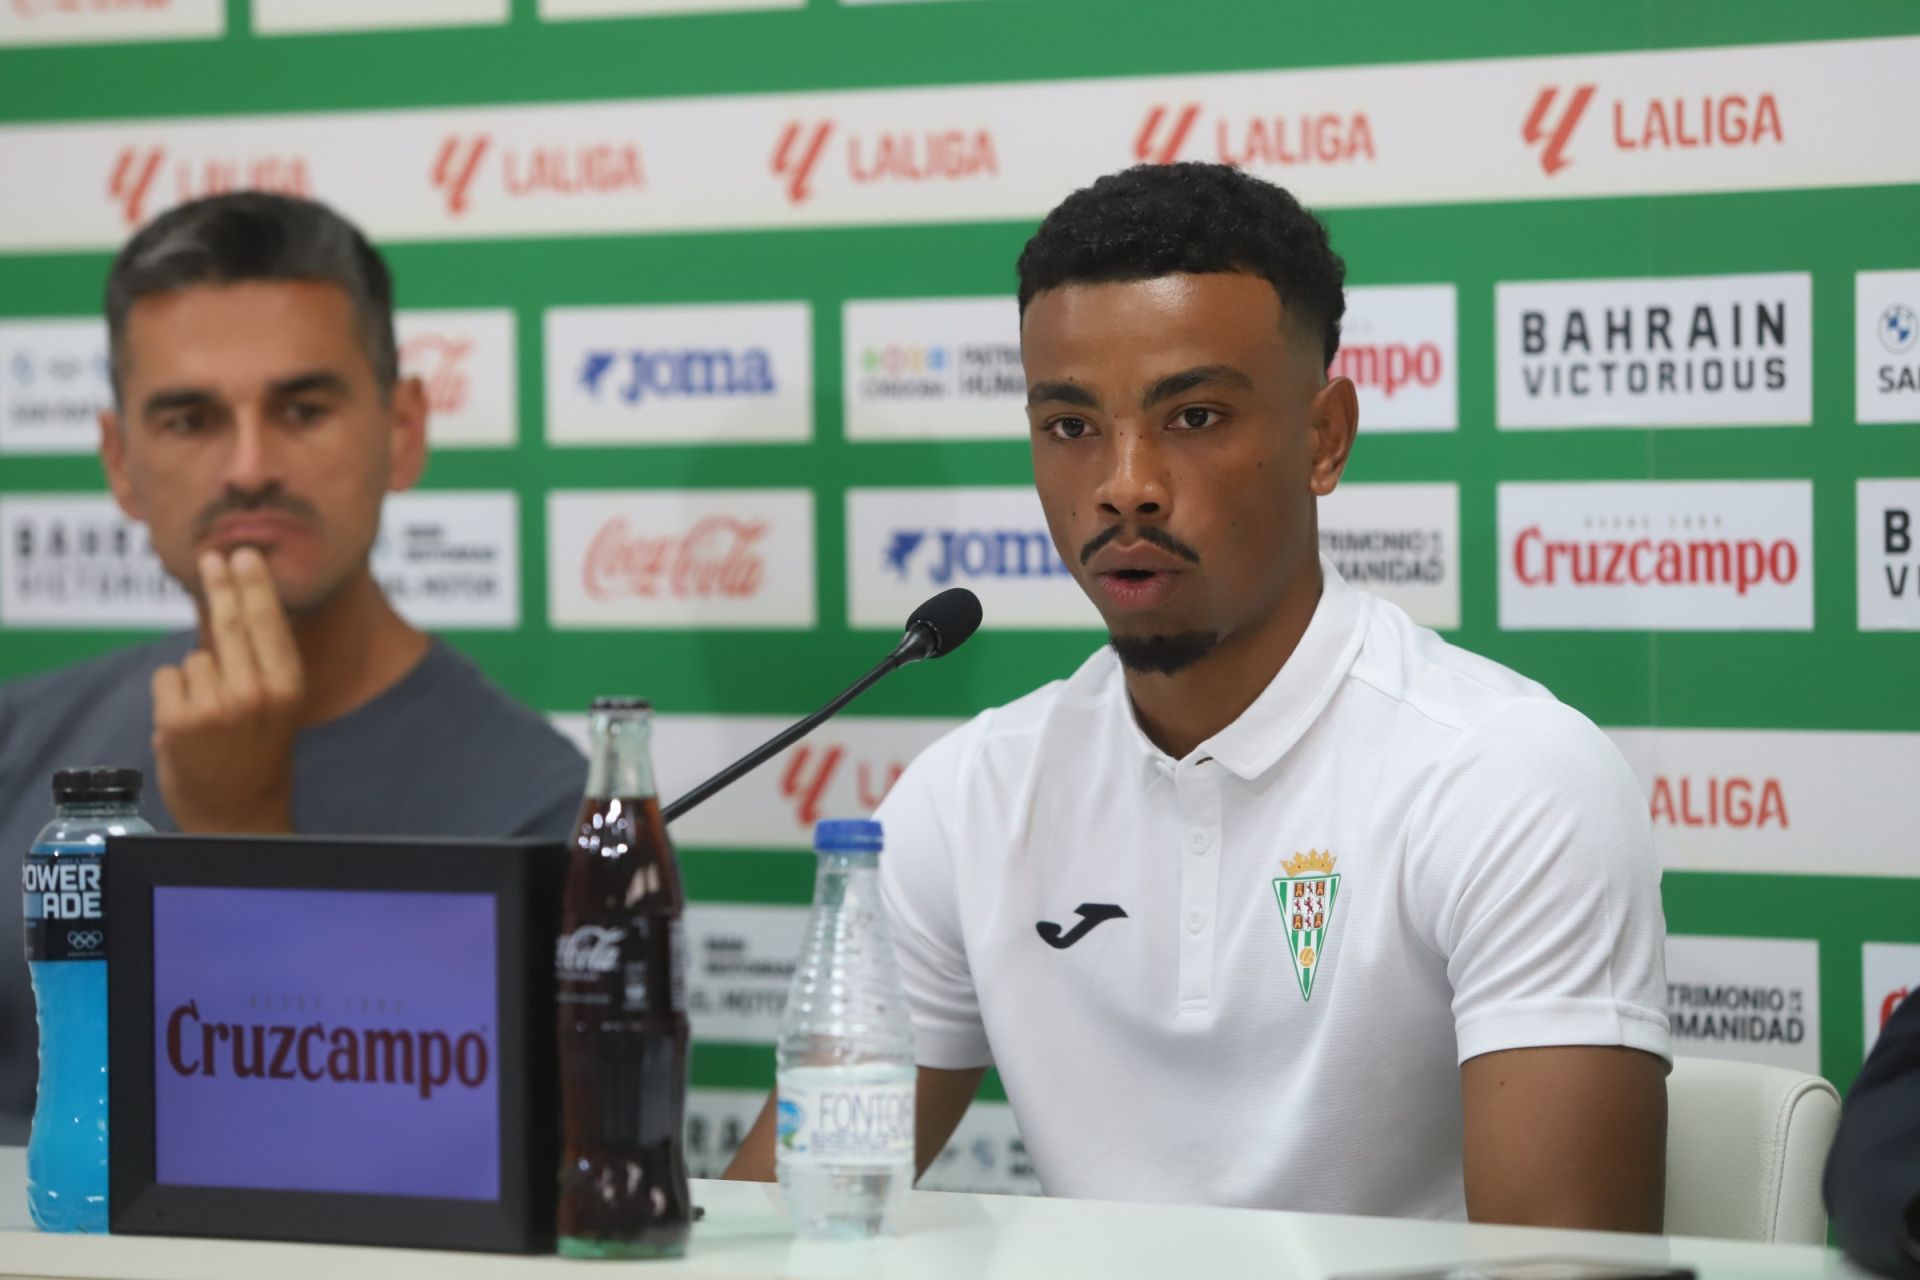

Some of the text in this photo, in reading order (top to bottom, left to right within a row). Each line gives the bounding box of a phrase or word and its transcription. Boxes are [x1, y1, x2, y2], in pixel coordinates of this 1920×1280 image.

[1216, 114, 1375, 165] LALIGA
[1614, 94, 1784, 149] LALIGA
[503, 146, 645, 195] LALIGA
[848, 131, 998, 182] LALIGA
[1521, 301, 1787, 354] BAHRAIN
[1328, 342, 1442, 396] mpo
[1522, 357, 1786, 398] VICTORIOUS
[1878, 365, 1920, 394] SA
[1318, 529, 1421, 553] TRIMONIO
[1512, 524, 1799, 597] Cruzcampo
[1650, 776, 1790, 829] ALIGA
[22, 864, 101, 892] OWER
[43, 892, 102, 919] ADE
[1667, 983, 1784, 1012] TRIMONIO
[166, 998, 489, 1100] Cruzcampo
